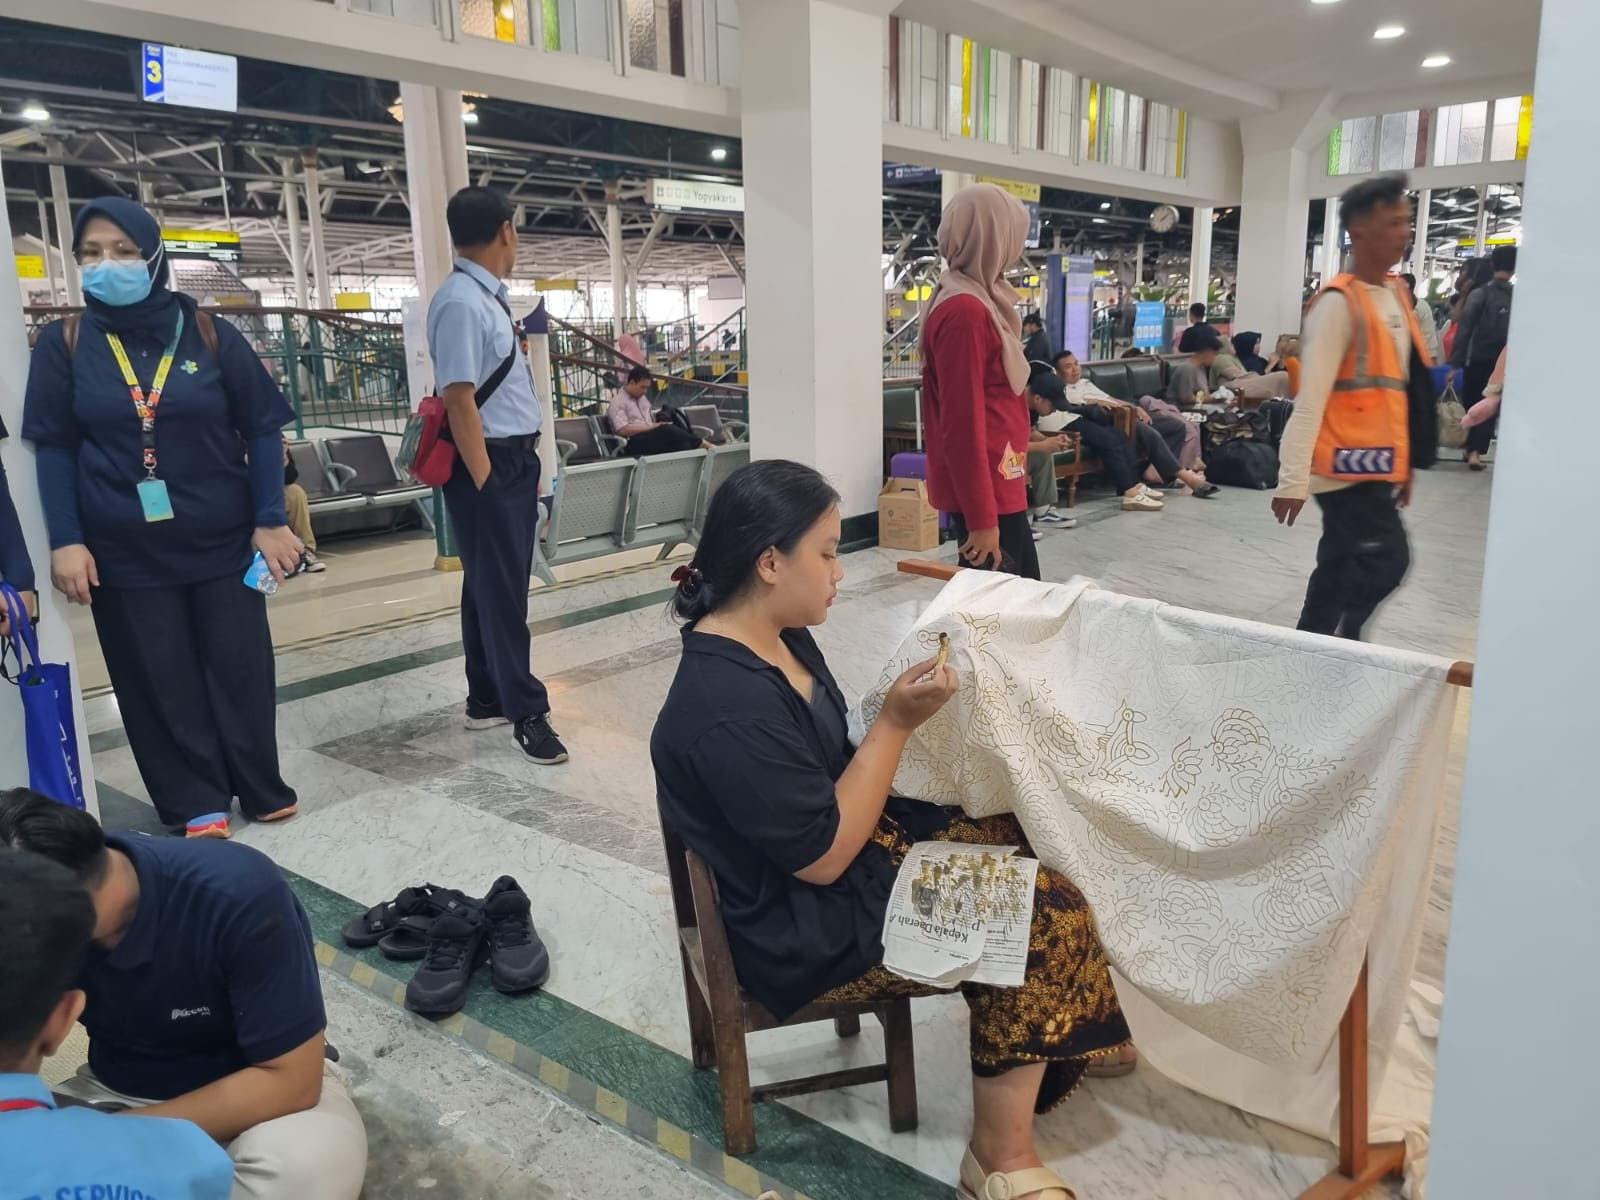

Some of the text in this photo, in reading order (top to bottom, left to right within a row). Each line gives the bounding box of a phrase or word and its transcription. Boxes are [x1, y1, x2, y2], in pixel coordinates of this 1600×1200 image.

[146, 60, 162, 84] 3
[694, 190, 736, 204] Yogyakarta
[898, 915, 932, 934] Daerah
[934, 925, 968, 943] Kepala
[55, 1183, 157, 1200] SERVIC
